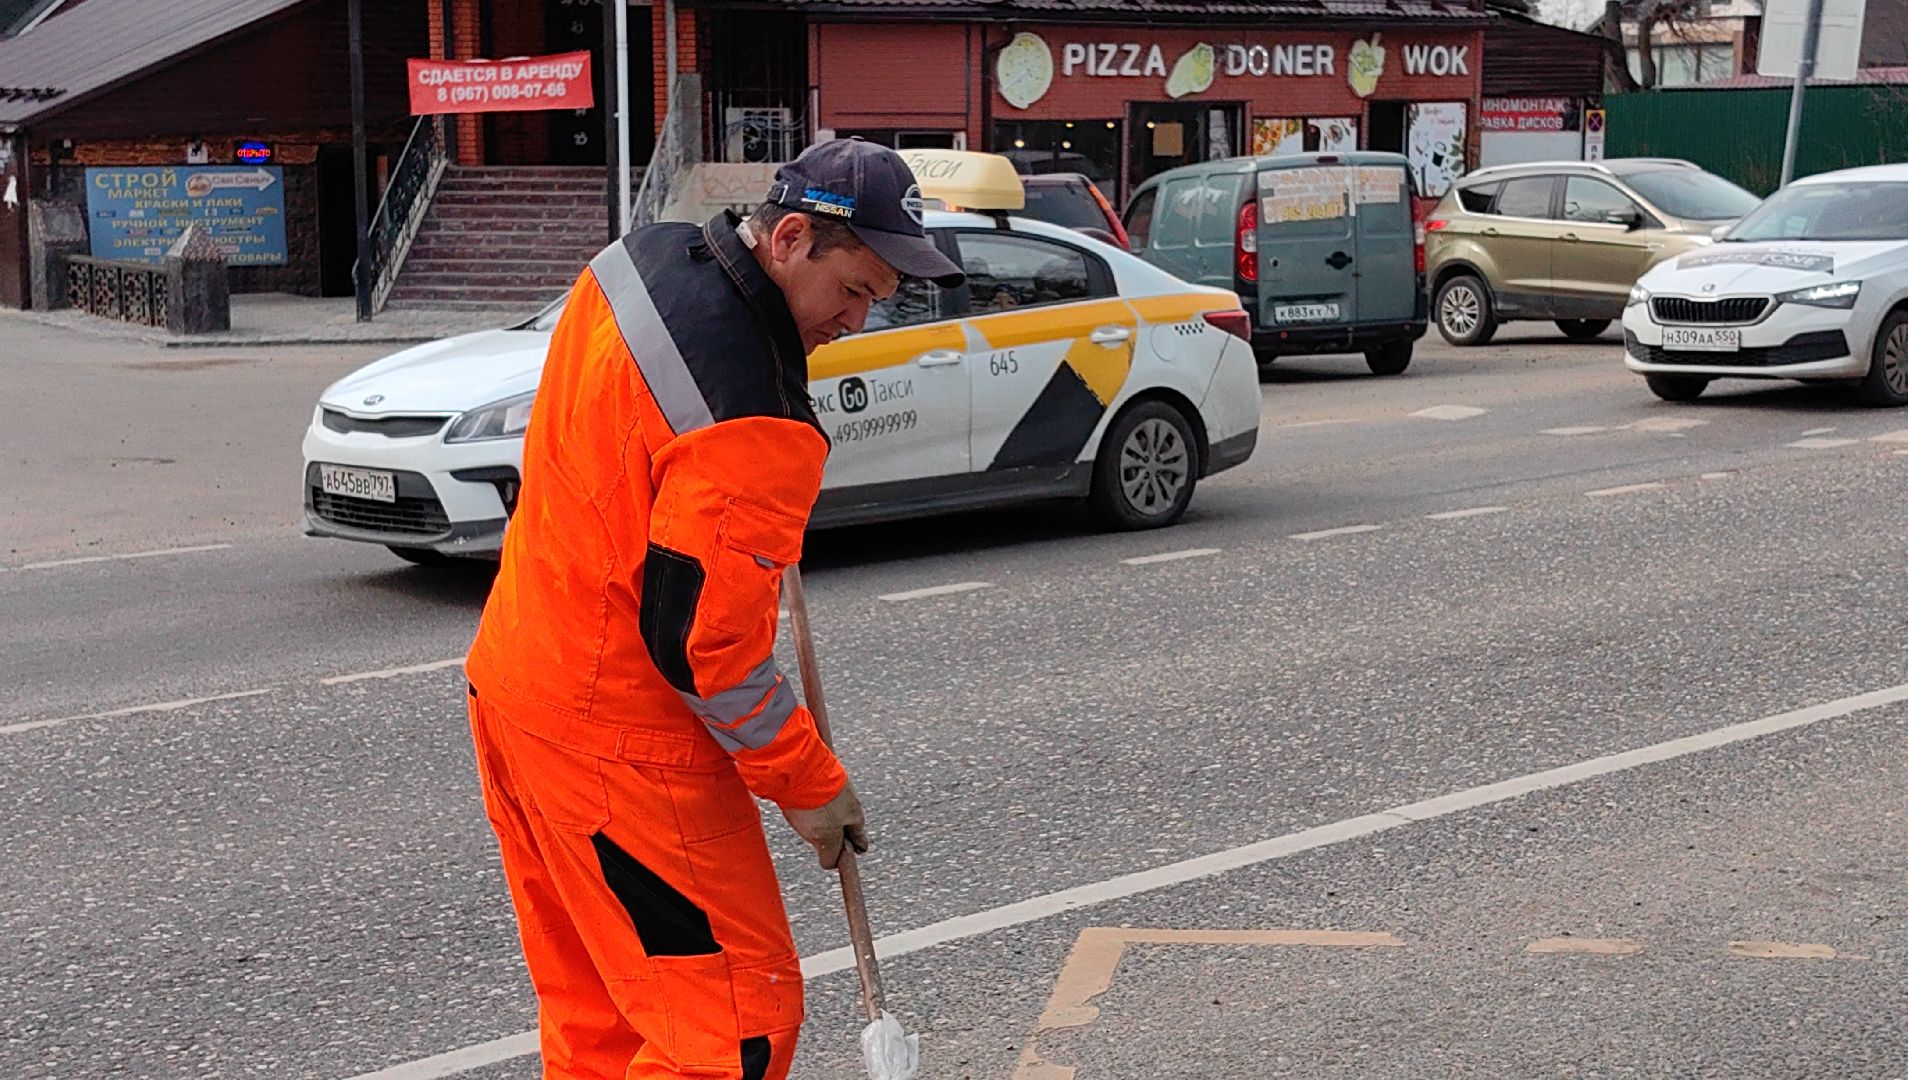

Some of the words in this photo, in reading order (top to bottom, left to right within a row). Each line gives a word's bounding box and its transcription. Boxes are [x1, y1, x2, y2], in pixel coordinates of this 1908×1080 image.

[1063, 43, 1167, 77] PIZZA
[1226, 44, 1336, 77] DONER
[1402, 44, 1470, 76] WOK
[418, 67, 497, 85] СДАЕТСЯ
[500, 66, 512, 81] В
[516, 63, 583, 81] АРЕНДУ
[437, 87, 447, 102] 8
[451, 86, 489, 103] (967)
[492, 83, 567, 99] 008-07-66
[1518, 116, 1564, 130] ДИСКОВ
[95, 167, 177, 188] СТРОЙ
[108, 188, 168, 199] МАРКЕТ
[135, 199, 188, 209] КРАСКИ
[207, 198, 242, 208] ЛАКИ
[814, 202, 853, 218] NISSAN
[175, 217, 264, 228] ИНСТРУМЕНТ
[990, 350, 1019, 376] 645
[842, 381, 866, 408] Go
[870, 378, 914, 405] Такси
